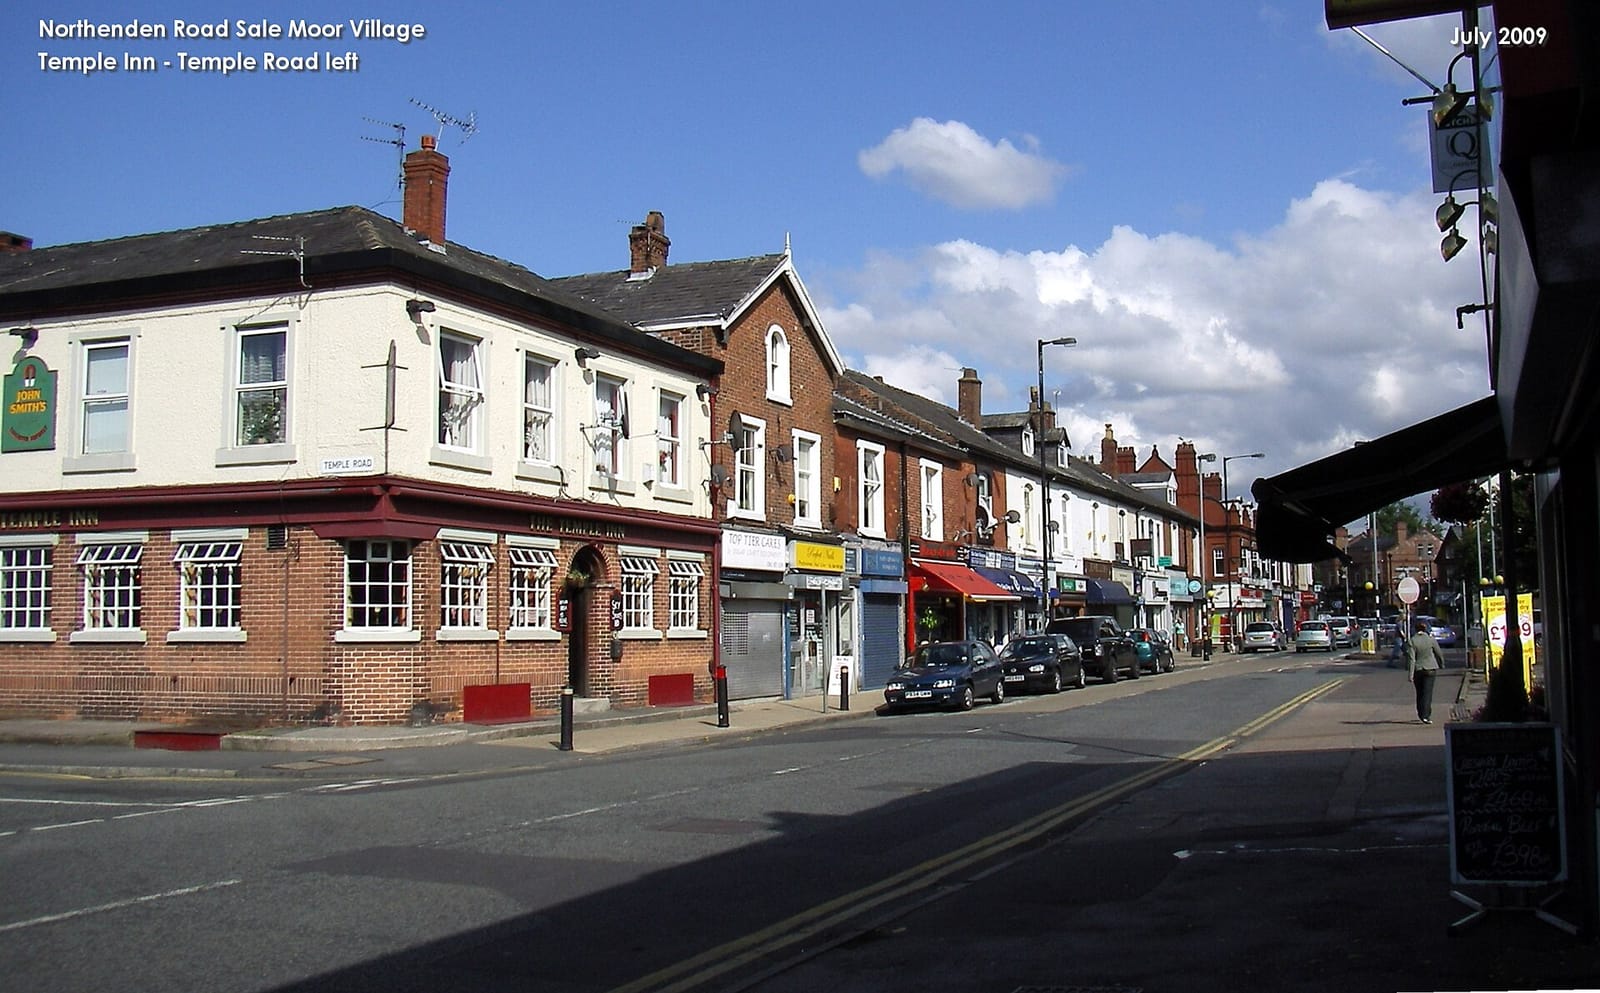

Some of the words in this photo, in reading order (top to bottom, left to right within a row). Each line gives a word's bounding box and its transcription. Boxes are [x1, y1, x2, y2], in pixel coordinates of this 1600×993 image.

[16, 389, 41, 402] JOHN
[9, 401, 47, 414] SMITH'S
[324, 460, 350, 470] TEMPLE
[353, 459, 373, 468] ROAD
[0, 511, 62, 529] TEMPLE
[69, 509, 99, 526] INN
[529, 514, 553, 531] THE
[559, 518, 601, 536] TEMPLE
[606, 523, 625, 539] INN
[729, 533, 742, 545] TOP
[744, 535, 760, 547] TIER
